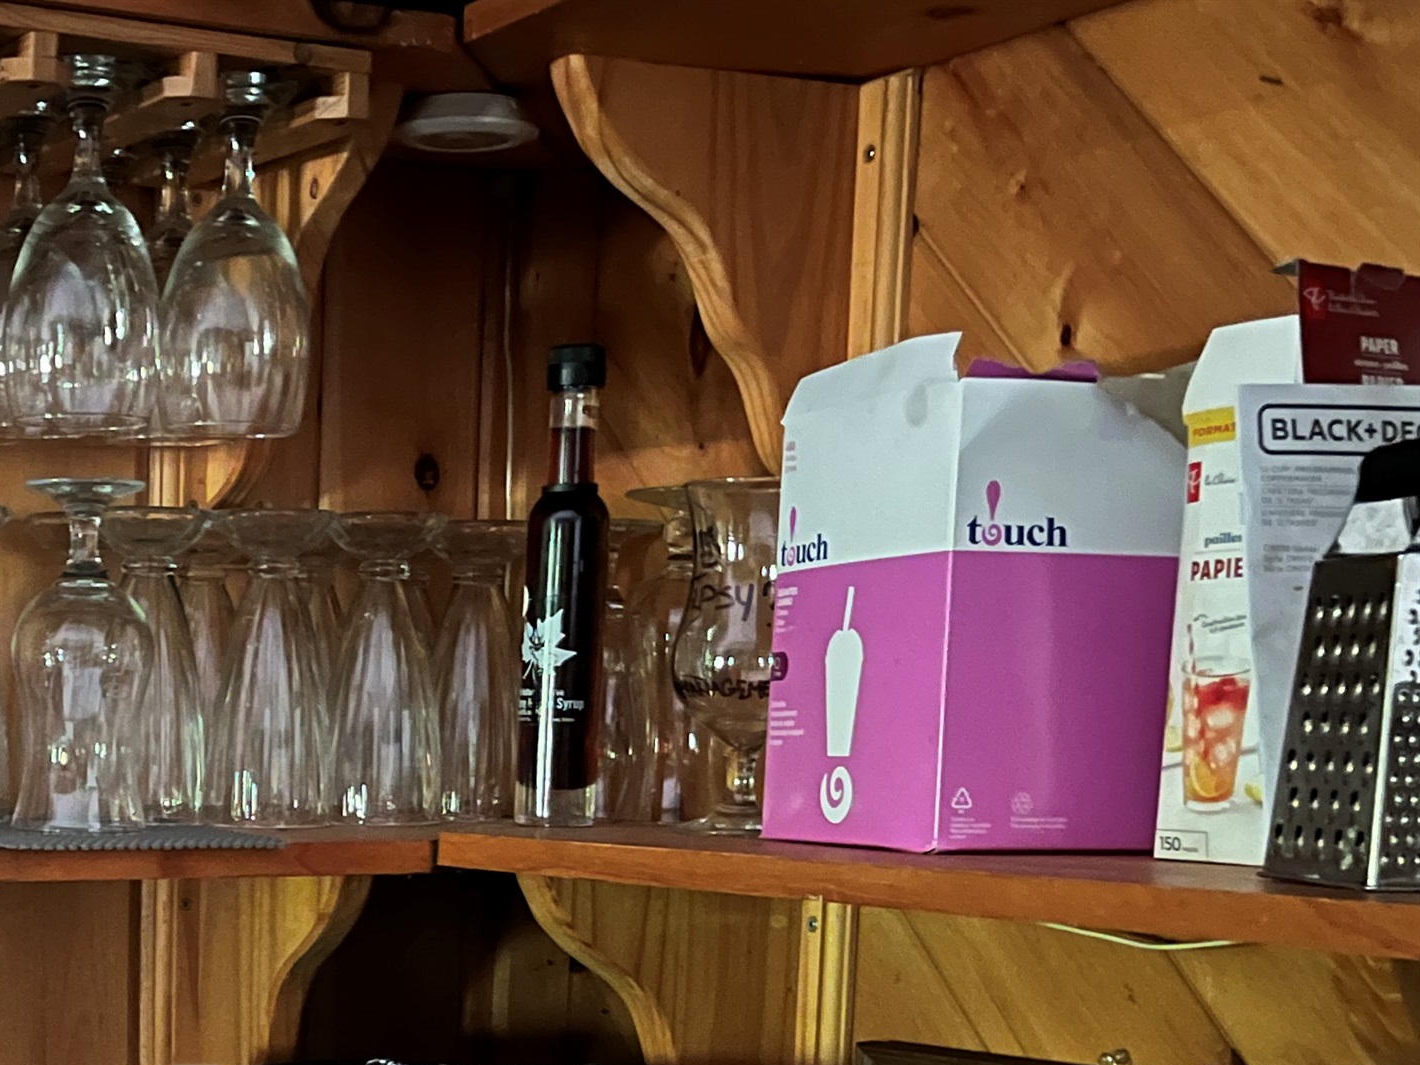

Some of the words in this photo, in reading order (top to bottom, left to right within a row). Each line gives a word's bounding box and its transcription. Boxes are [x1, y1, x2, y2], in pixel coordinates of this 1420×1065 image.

[1360, 335, 1399, 355] PAPER
[1271, 417, 1420, 442] BLACK+DE
[967, 515, 1069, 548] touch
[780, 533, 829, 567] touch
[1159, 836, 1182, 852] 150
